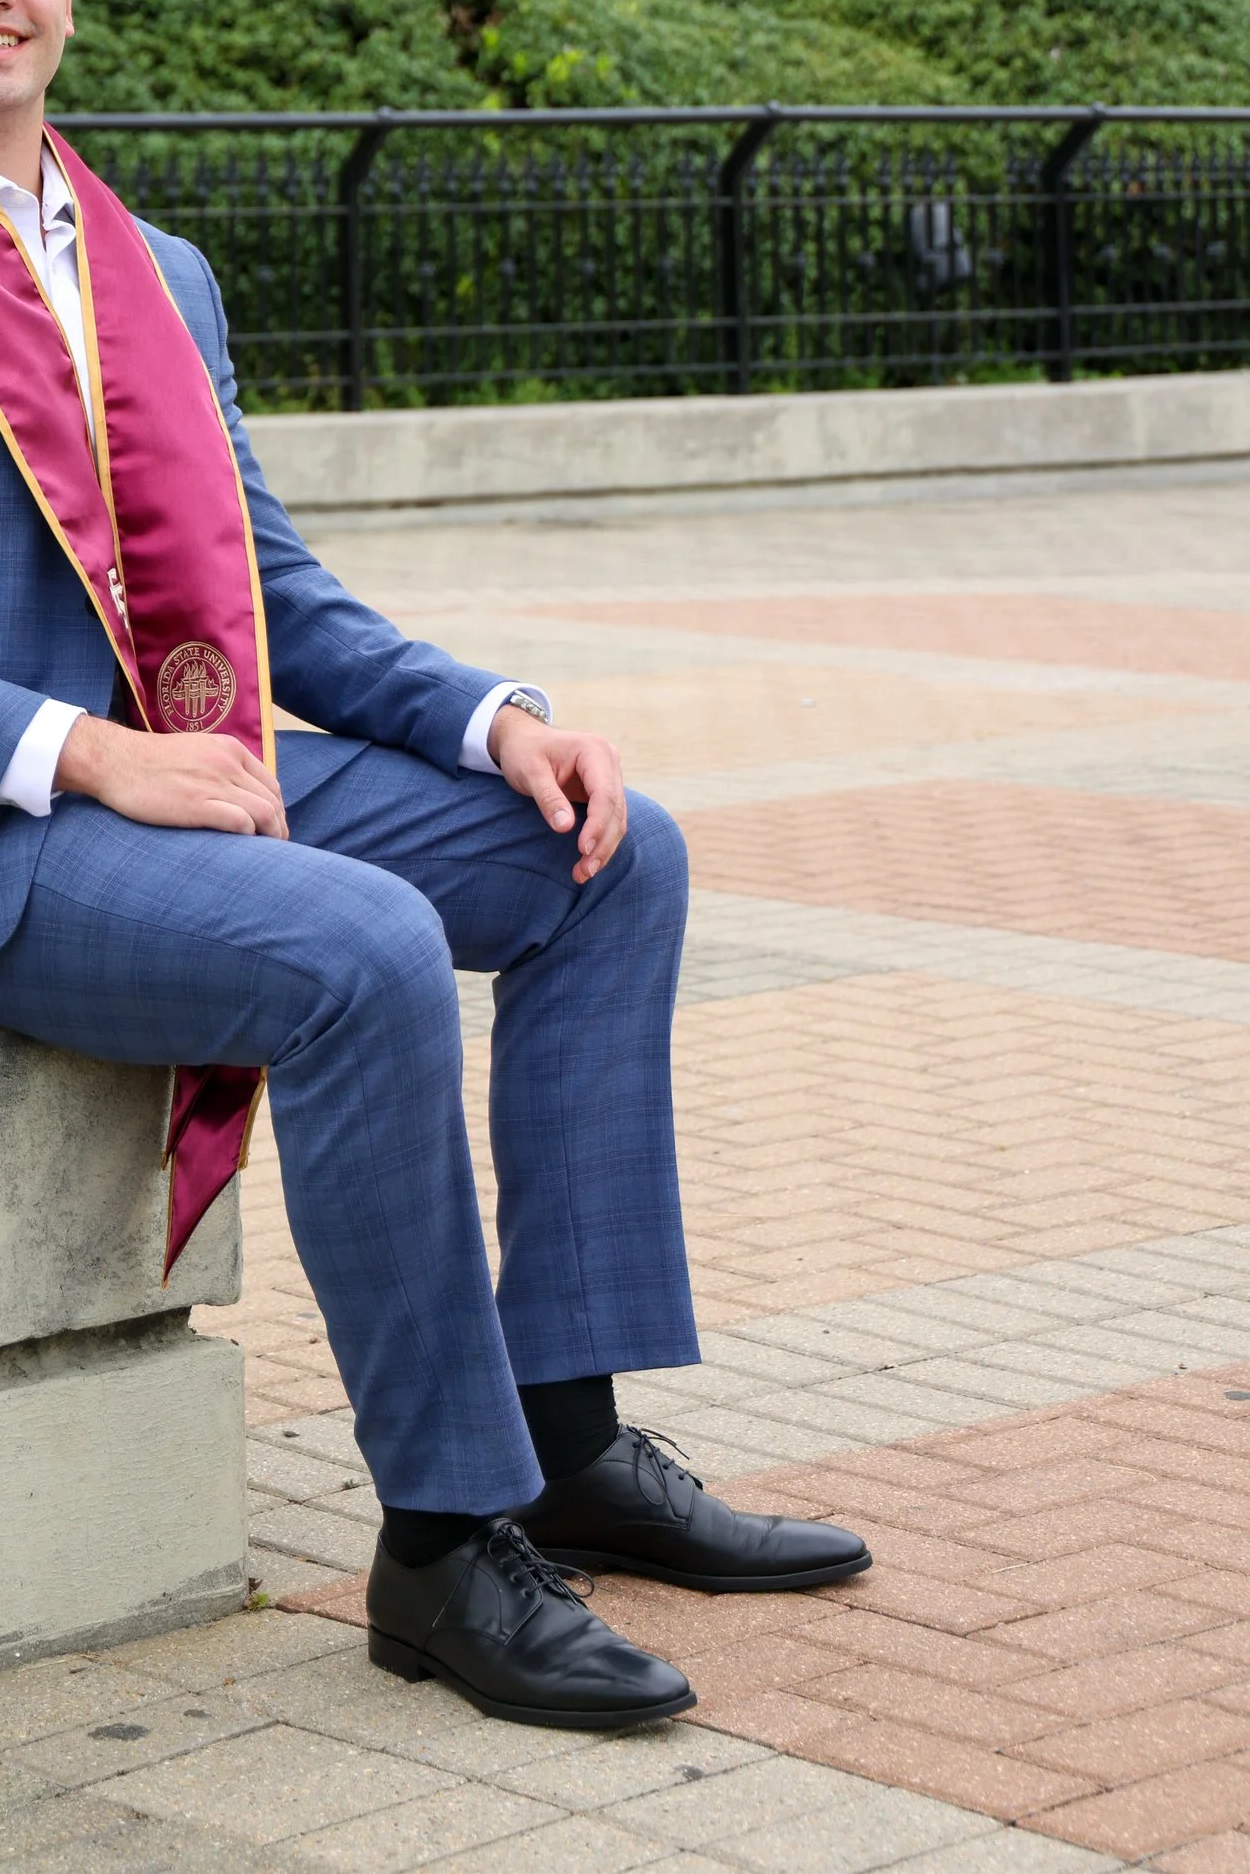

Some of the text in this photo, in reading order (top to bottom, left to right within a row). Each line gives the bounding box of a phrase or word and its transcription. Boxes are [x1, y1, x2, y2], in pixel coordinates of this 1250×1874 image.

[161, 647, 231, 716] FLORIDA STATE UNIVERSITY
[185, 721, 204, 732] 1851
